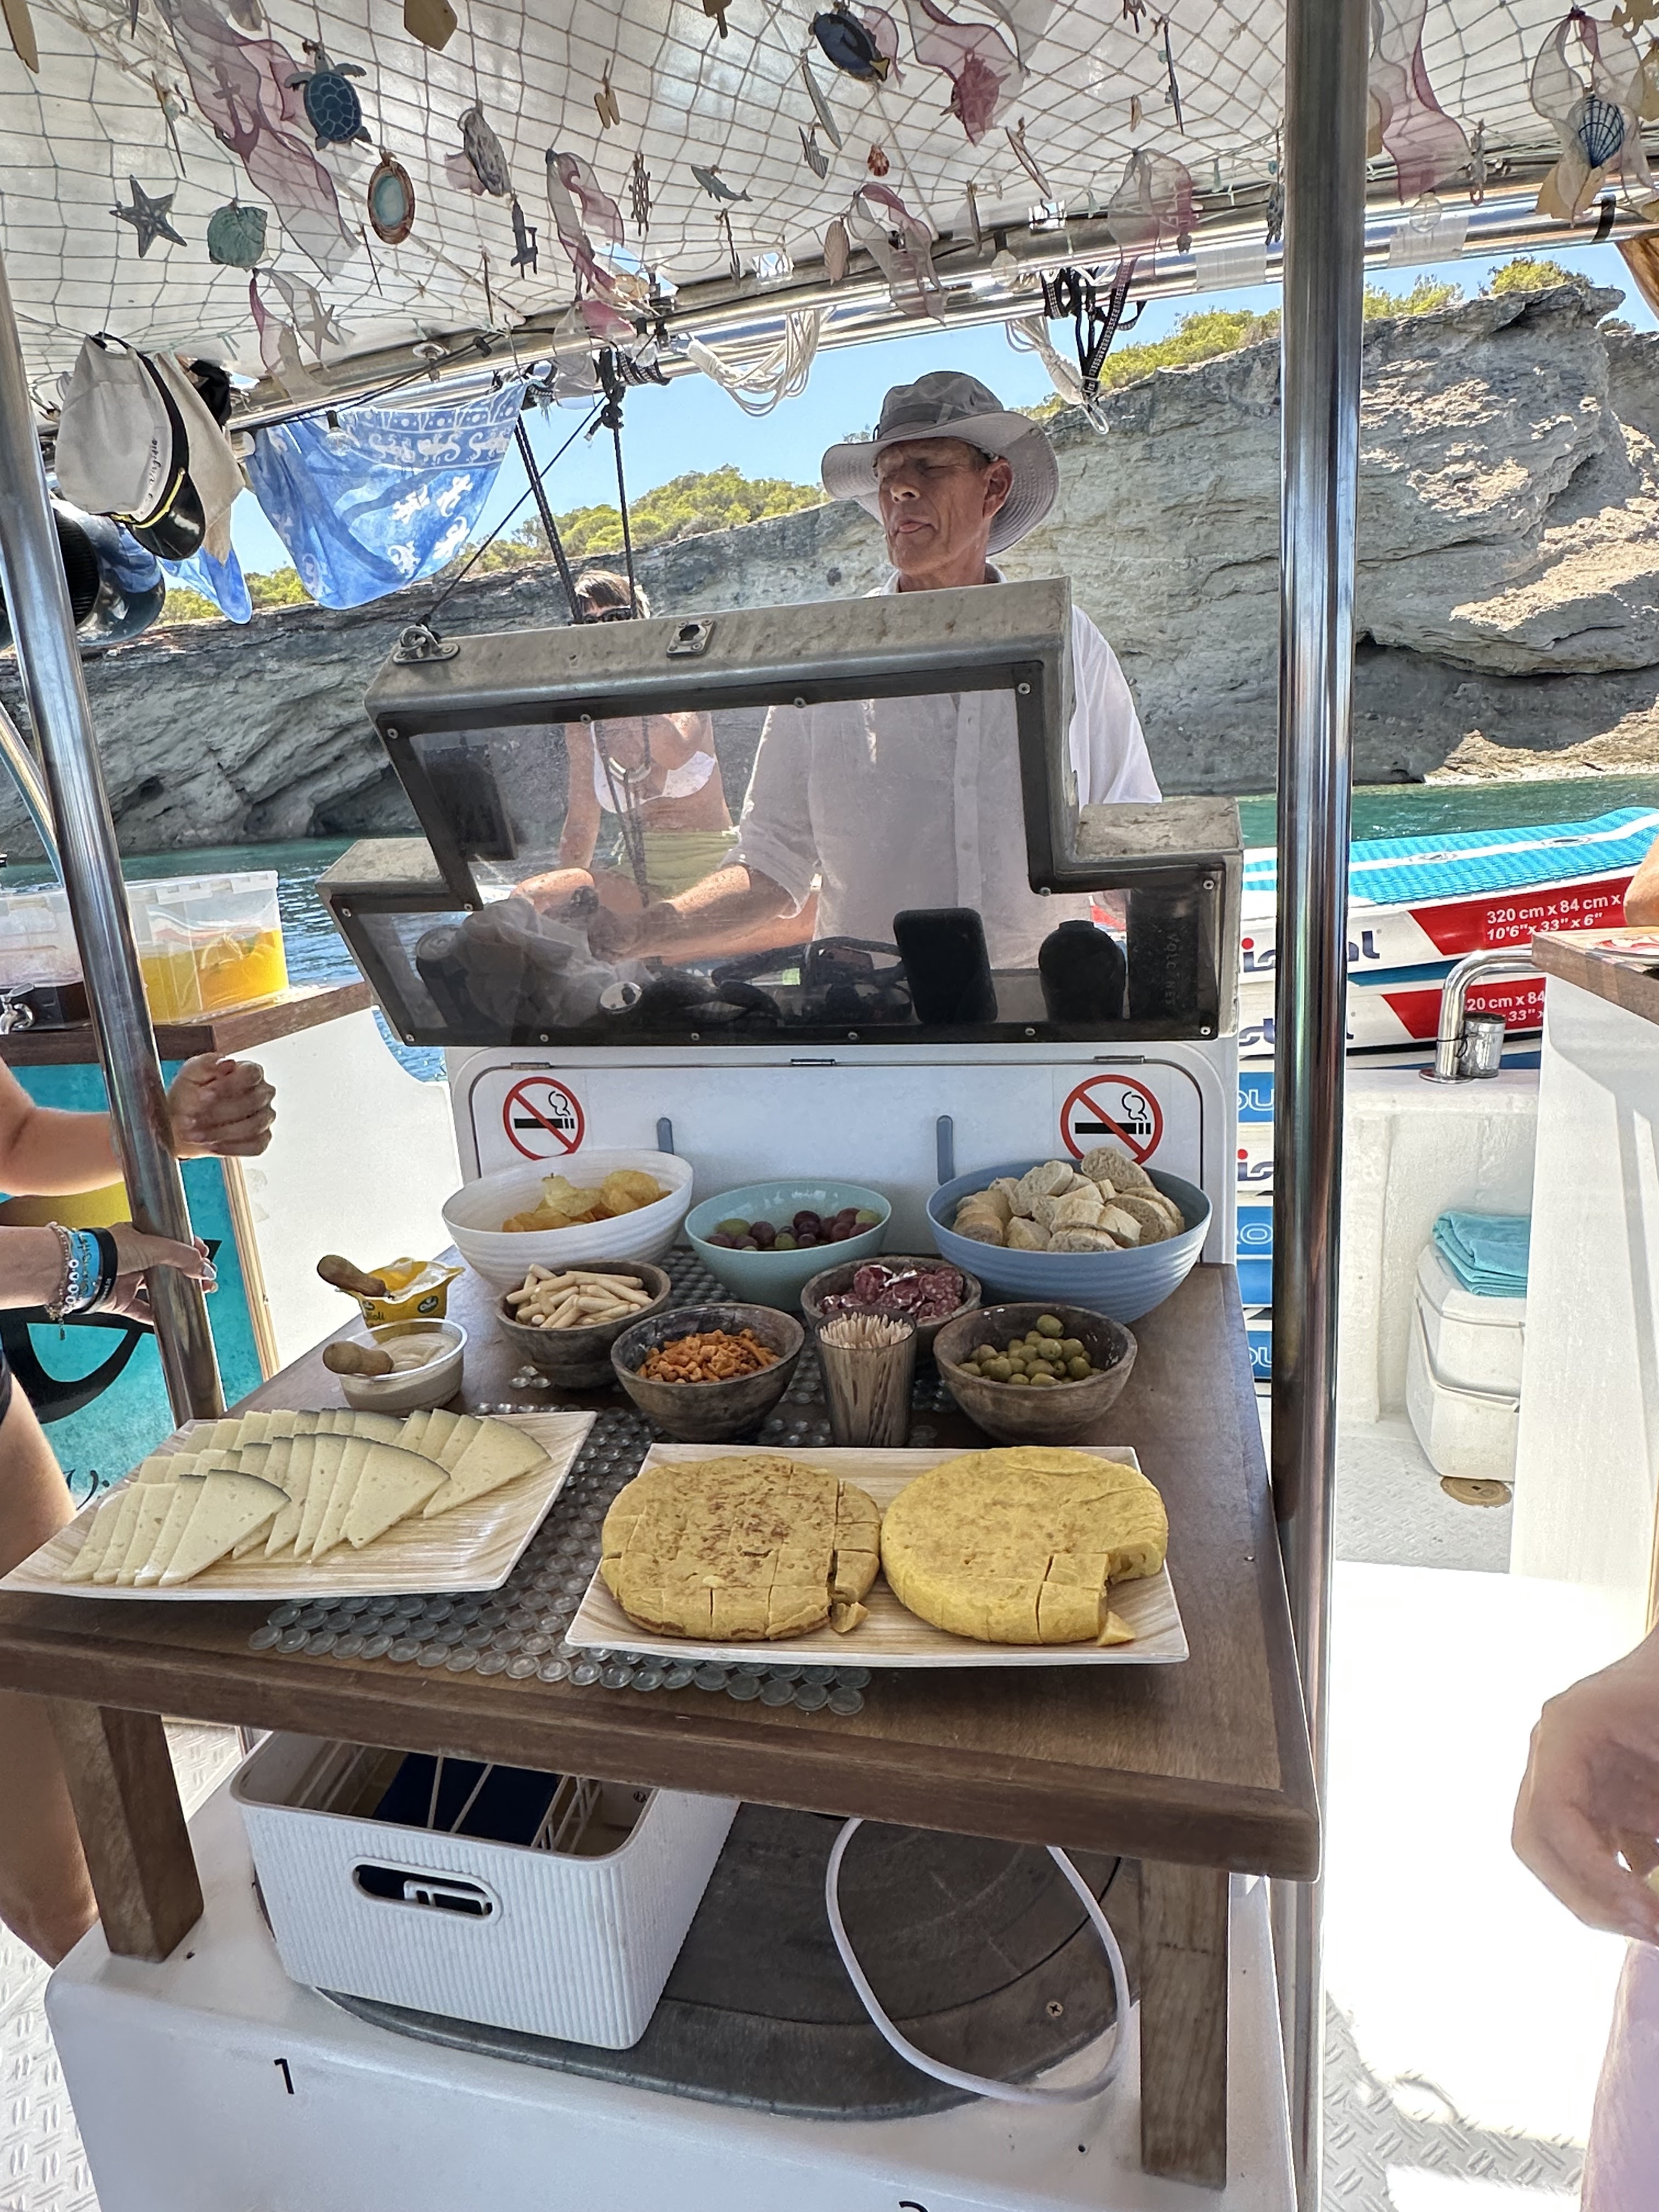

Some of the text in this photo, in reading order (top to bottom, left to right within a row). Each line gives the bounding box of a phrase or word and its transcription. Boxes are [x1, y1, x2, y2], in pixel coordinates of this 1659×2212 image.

[1487, 894, 1621, 924] 320 cm x 84 cm x
[1571, 918, 1581, 928] x
[1465, 997, 1486, 1011] 20
[1488, 997, 1513, 1008] cm
[1515, 995, 1525, 1006] x
[274, 2058, 295, 2095] 1
